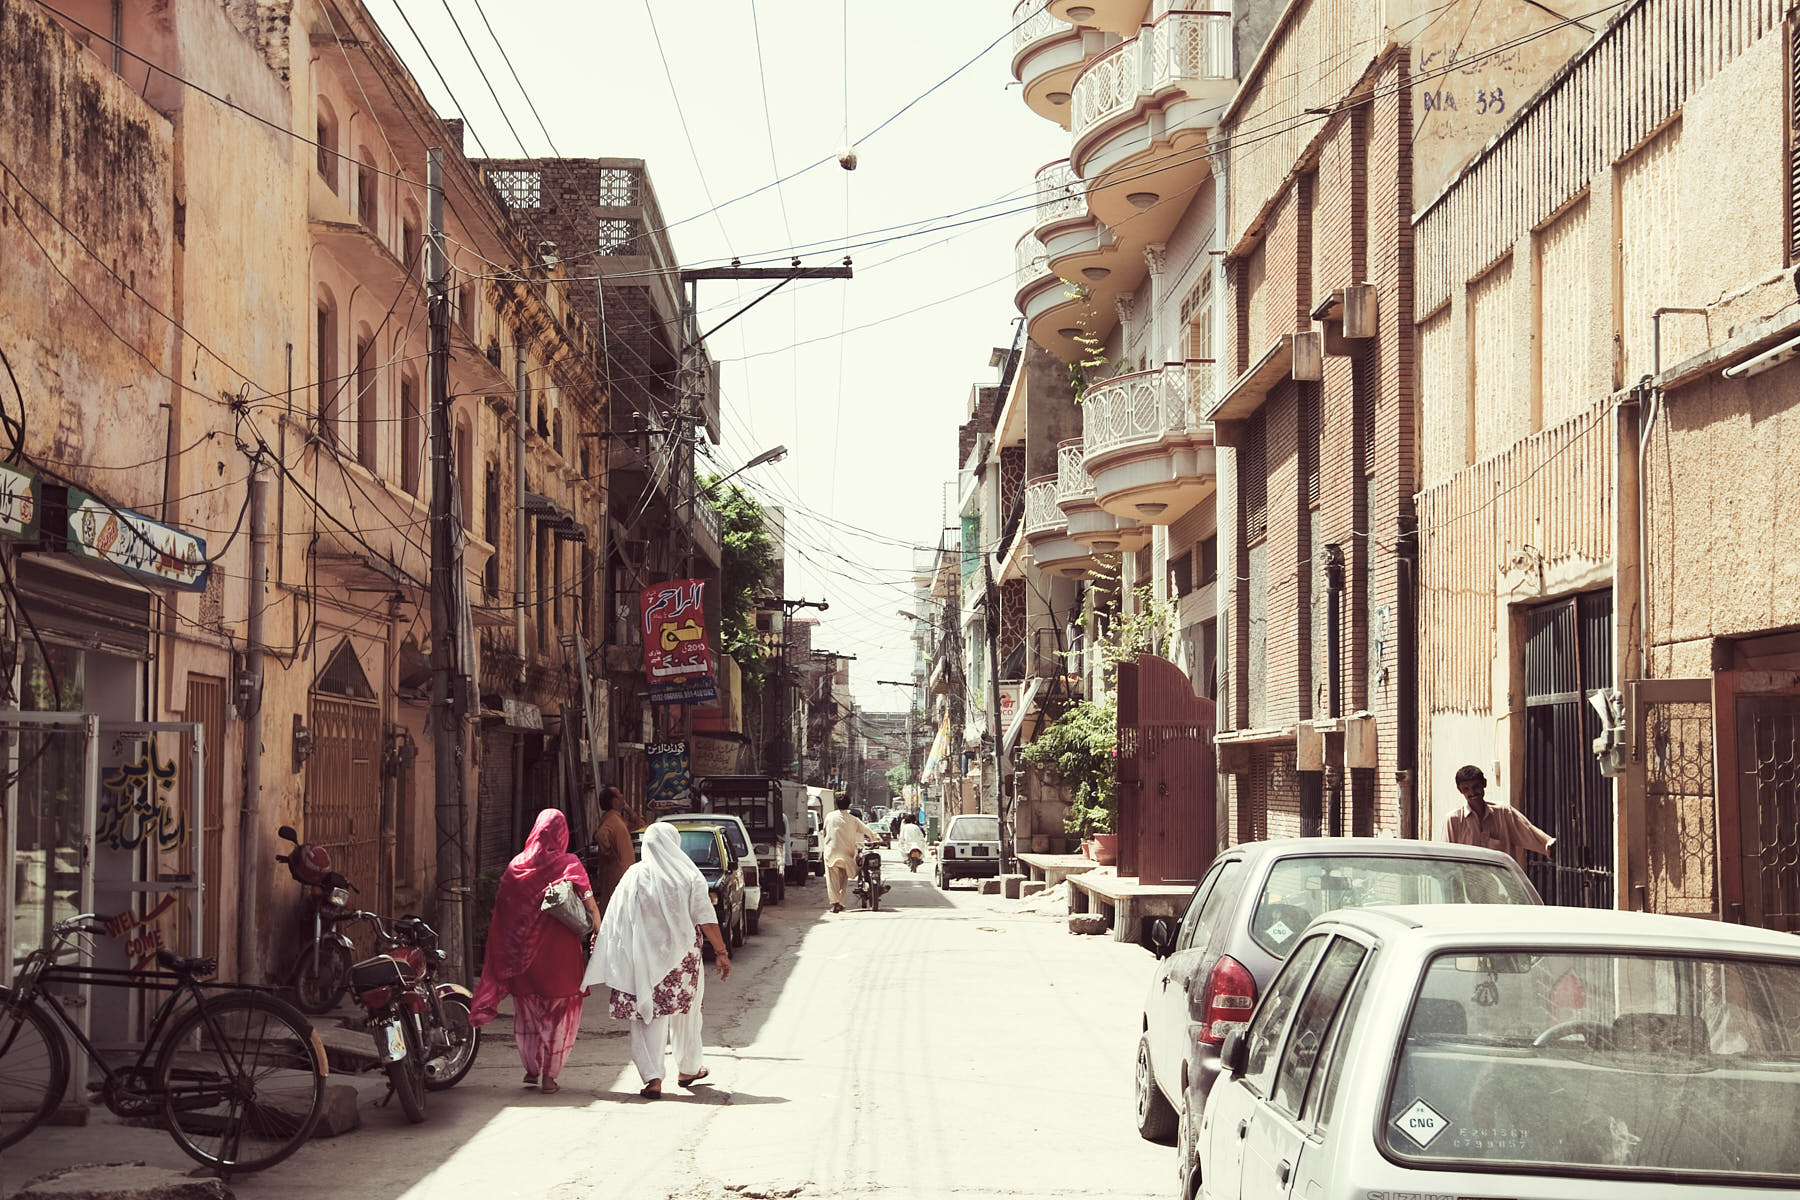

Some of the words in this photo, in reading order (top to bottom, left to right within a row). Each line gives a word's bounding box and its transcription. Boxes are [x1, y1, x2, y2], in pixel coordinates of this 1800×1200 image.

[660, 619, 703, 651] حج
[652, 655, 708, 677] بکنگ
[103, 735, 176, 791] بابر
[104, 909, 141, 938] WEL
[125, 930, 163, 957] COME
[1409, 1118, 1434, 1128] CNG
